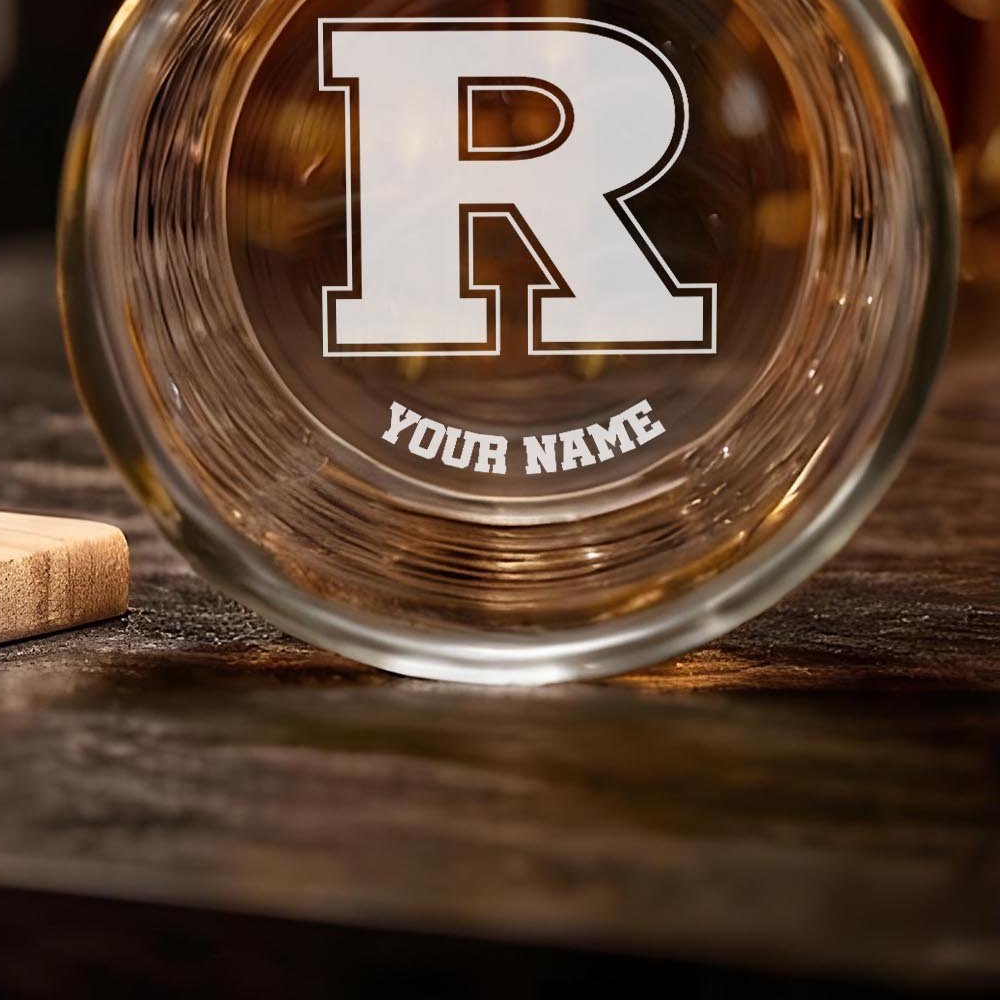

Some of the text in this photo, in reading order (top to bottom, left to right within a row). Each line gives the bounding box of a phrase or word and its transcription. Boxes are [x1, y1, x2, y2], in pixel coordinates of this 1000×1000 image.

[318, 17, 717, 357] R
[382, 399, 666, 474] YOUR NAME
